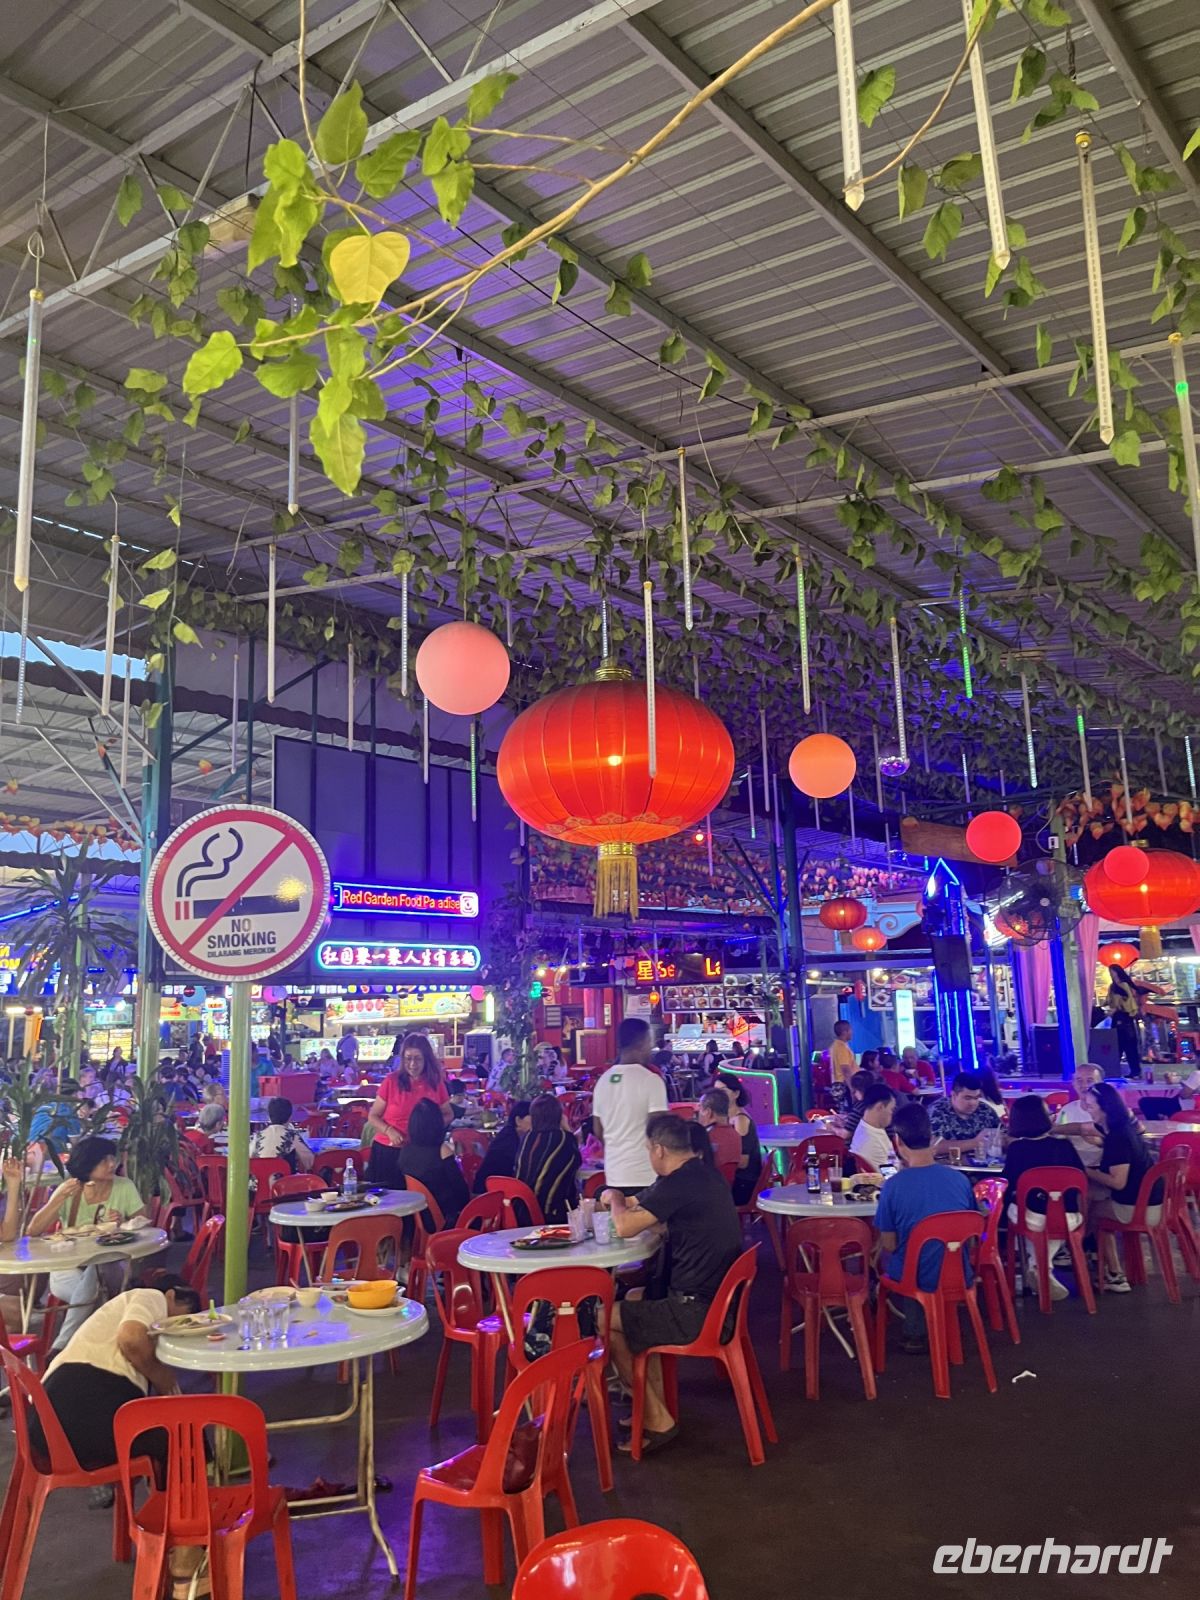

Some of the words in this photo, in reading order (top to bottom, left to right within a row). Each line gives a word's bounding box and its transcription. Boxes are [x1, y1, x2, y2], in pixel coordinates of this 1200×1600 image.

[342, 889, 362, 904] Red
[364, 891, 398, 907] Garden
[400, 893, 423, 908] Food
[231, 918, 252, 933] NO
[207, 930, 277, 949] SMOKING
